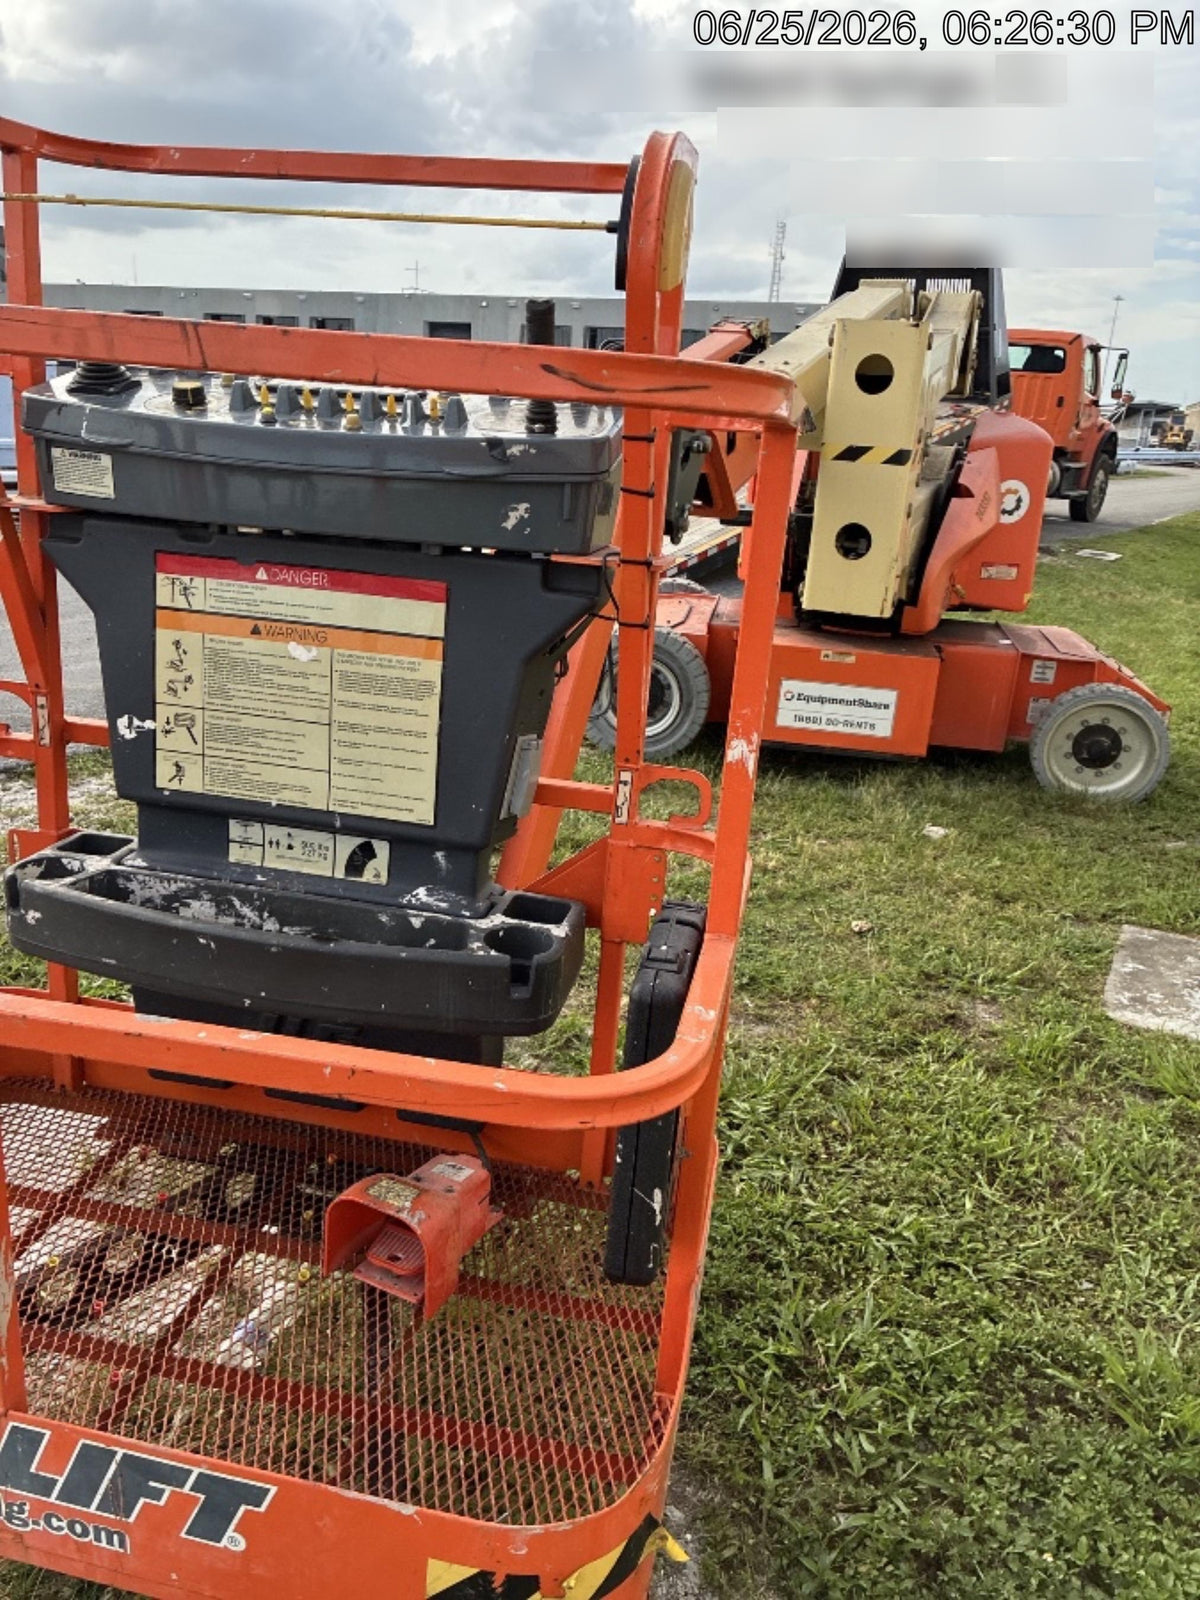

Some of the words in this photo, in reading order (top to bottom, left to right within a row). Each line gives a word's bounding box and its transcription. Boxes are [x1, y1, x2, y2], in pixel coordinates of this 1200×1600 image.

[269, 567, 329, 588] DANGER
[263, 623, 328, 644] WARNING
[796, 692, 890, 710] EquipmentShare
